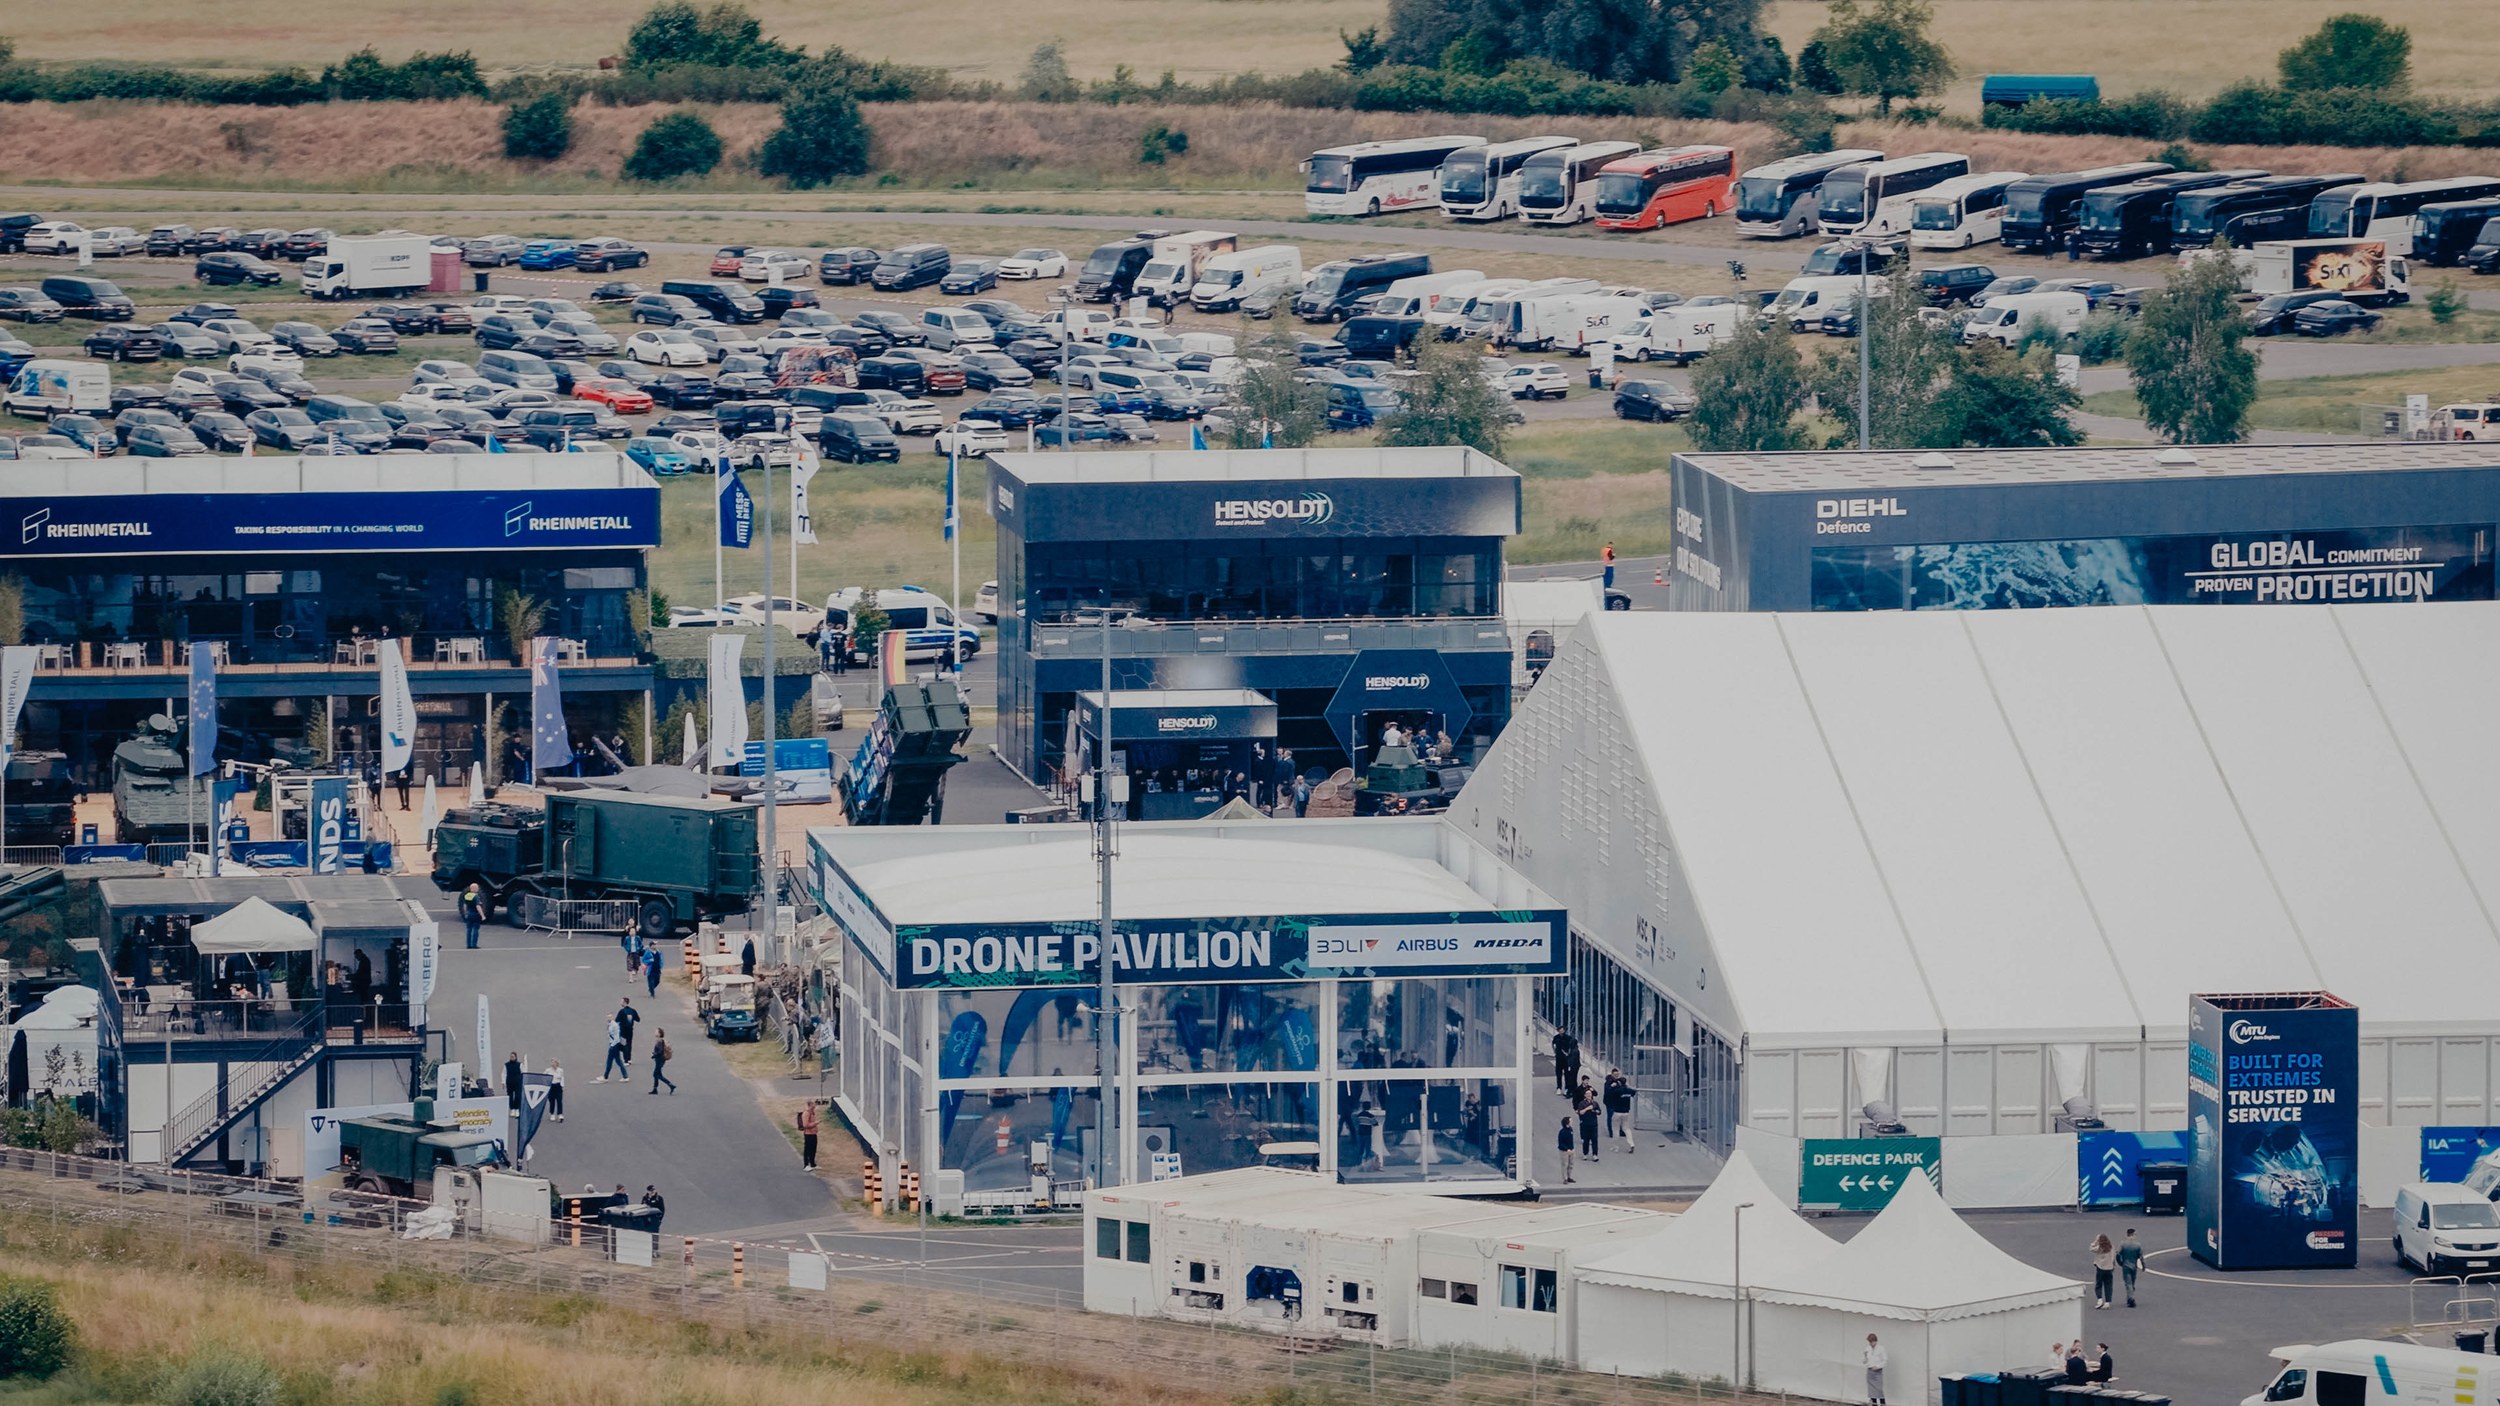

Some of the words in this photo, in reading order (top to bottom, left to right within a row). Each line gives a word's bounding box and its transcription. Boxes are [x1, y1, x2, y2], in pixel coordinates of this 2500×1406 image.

[1215, 500, 1327, 519] HENSOLDT
[1817, 498, 1907, 518] DIEHL
[47, 523, 152, 537] RHEINMETALL
[234, 526, 264, 534] TAKING
[265, 525, 332, 534] RESPONSIBILITY
[333, 525, 342, 533] IN
[344, 525, 350, 533] A
[351, 525, 393, 533] CHANGING
[529, 516, 632, 530] RHEINMETALL
[1817, 520, 1871, 534] Defence
[2211, 540, 2324, 568] GLOBAL
[2327, 547, 2422, 564] COMMITMENT
[2195, 577, 2253, 593] PROVEN
[2257, 571, 2434, 601] PROTECTION
[1366, 676, 1426, 687] HENSOLDT
[1158, 718, 1214, 728] HENSOLDT
[319, 796, 342, 873] NDS
[1396, 938, 1458, 951] AIRBUS
[1473, 938, 1543, 948] MBDA
[912, 935, 1063, 975] DRONE
[1073, 930, 1271, 971] PAVILION
[2240, 1026, 2267, 1036] MTU
[2229, 1055, 2282, 1070] BUILT
[2287, 1053, 2324, 1068] FOR
[2229, 1072, 2321, 1087] EXTREMES
[2228, 1089, 2308, 1105] TRUSTED
[2313, 1089, 2335, 1103] IN
[453, 1109, 490, 1119] Defending
[2228, 1107, 2302, 1123] SERVICE
[2428, 1138, 2449, 1150] ILA
[1813, 1154, 1881, 1166] DEFENCE
[1885, 1152, 1923, 1165] PARK
